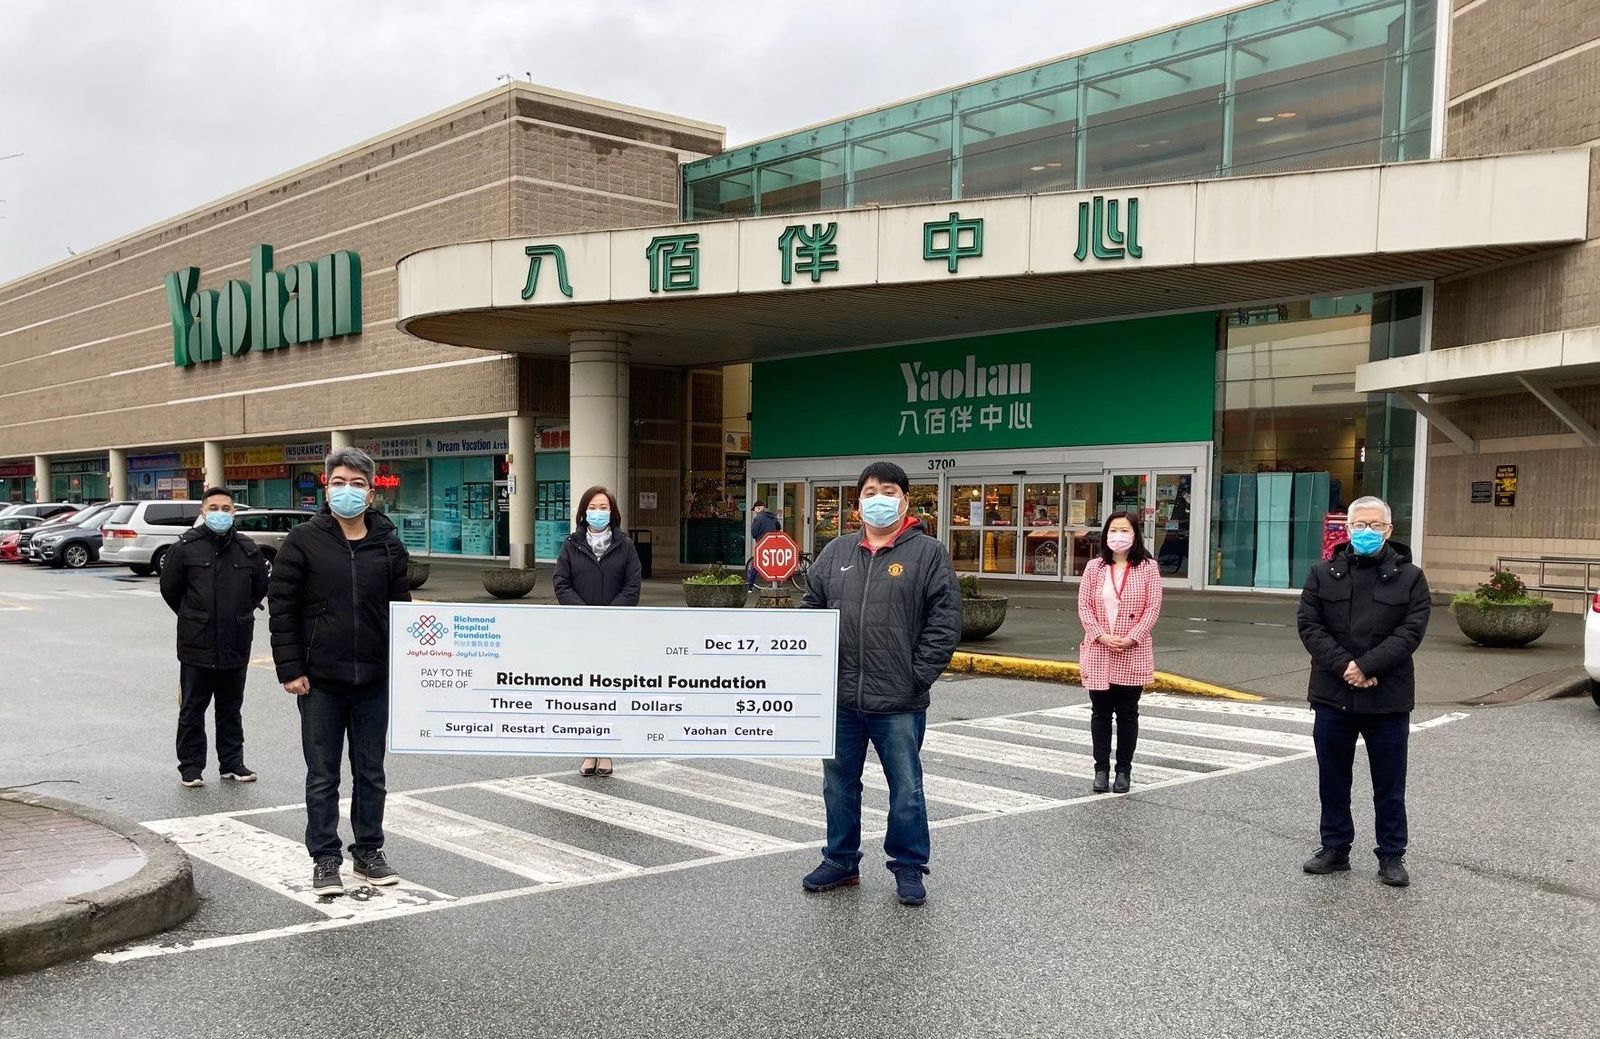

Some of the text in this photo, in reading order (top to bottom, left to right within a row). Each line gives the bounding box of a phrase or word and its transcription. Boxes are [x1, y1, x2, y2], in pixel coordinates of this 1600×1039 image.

[521, 195, 1143, 300] 八佰伴中心
[165, 244, 362, 367] Yaohan
[900, 355, 1031, 402] Yaohan
[899, 401, 1033, 436] 八佰伴中心
[285, 444, 323, 456] INSURANCE
[437, 440, 460, 452] Dream
[461, 439, 491, 451] Vacation
[928, 459, 956, 470] 3700
[762, 548, 792, 567] STOP
[453, 616, 496, 624] Richmond
[453, 624, 489, 632] Hospital
[453, 632, 501, 640] Foundation
[406, 649, 501, 659] Joyful Giving. Joyful Living.
[666, 639, 808, 656] DATE Dec 17, 2020
[421, 668, 473, 678] PAY TO THE
[496, 671, 767, 691] Richmond Hospital Foundation
[421, 679, 469, 689] ORDER OF
[490, 697, 793, 714] Three Thousand Dollars $3,000
[420, 722, 611, 738] RE Surgical Restart Campaign
[647, 726, 774, 742] PER Yaohan Centre
